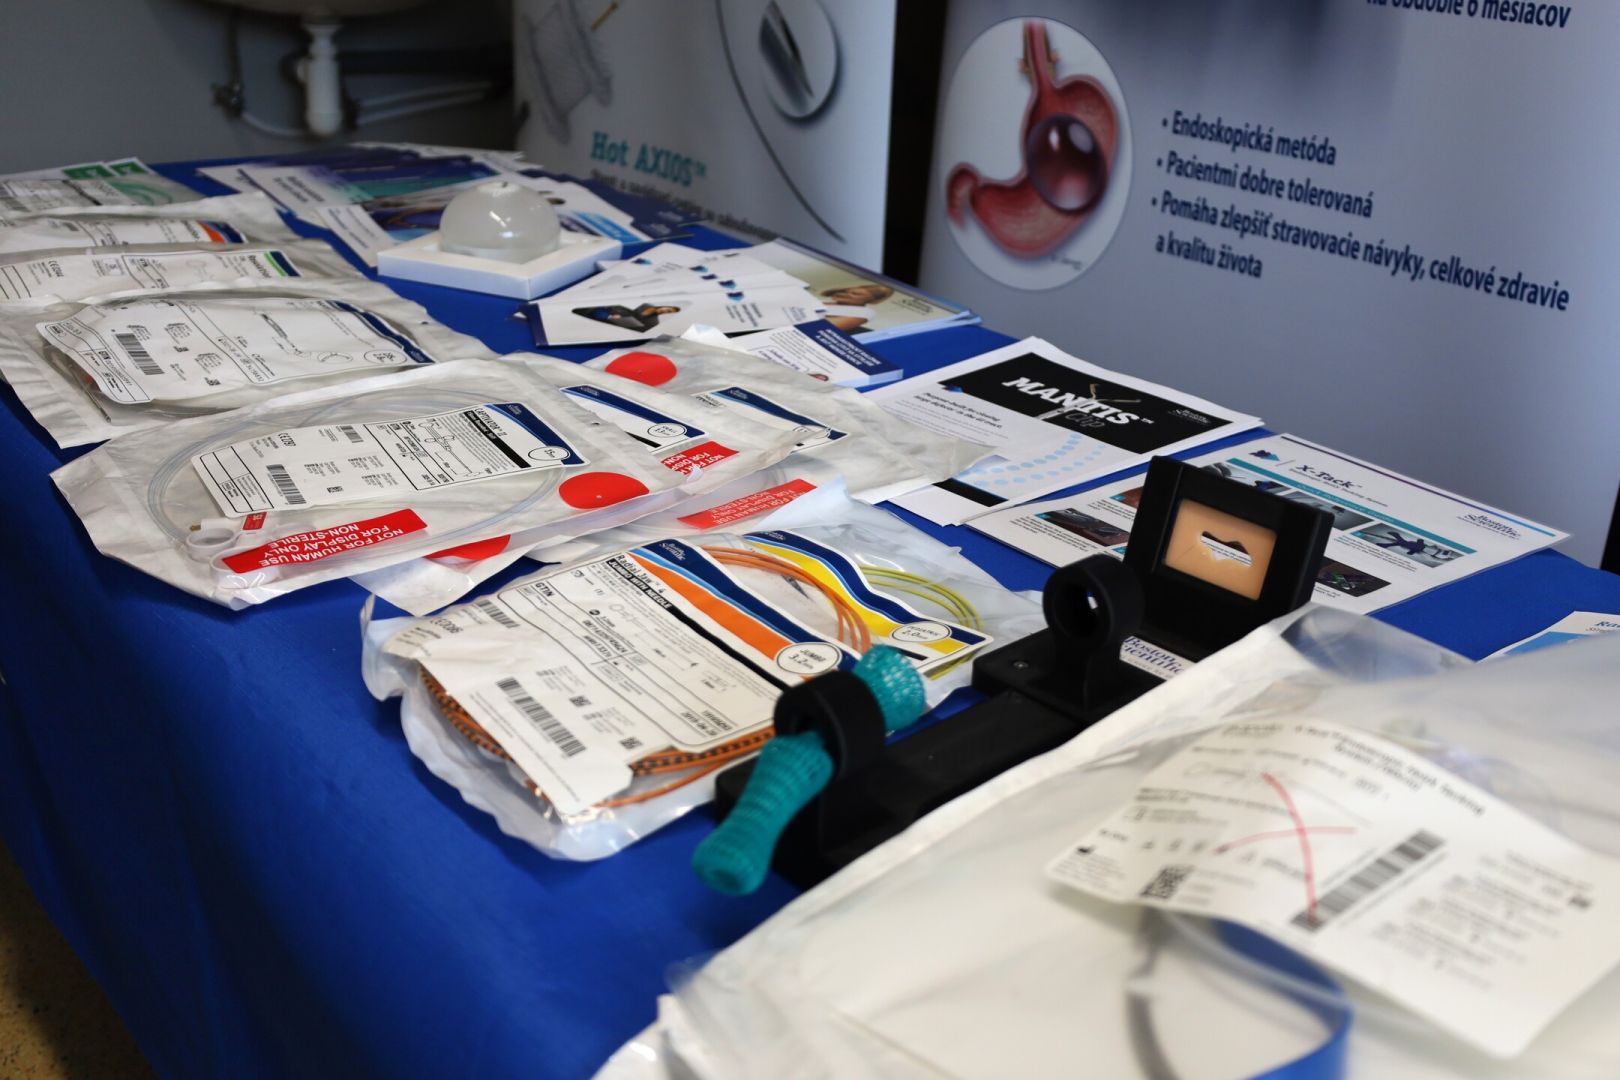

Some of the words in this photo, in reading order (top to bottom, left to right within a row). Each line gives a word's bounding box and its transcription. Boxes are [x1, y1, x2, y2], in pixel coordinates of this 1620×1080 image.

[1172, 110, 1273, 152] Endoskopická
[1275, 135, 1337, 166] metóda
[590, 130, 629, 166] Hot
[1166, 150, 1239, 188] Pacientmi
[1239, 166, 1285, 198] dobre
[1288, 178, 1374, 218] tolerovaná
[1156, 235, 1165, 254] a
[1166, 231, 1215, 265] kvalitu
[1217, 244, 1263, 279] života
[1161, 189, 1218, 225] Pomáha
[1220, 204, 1273, 238] zlepšiť
[1272, 220, 1361, 260] stravovacie
[1362, 239, 1426, 281] návyky,
[1429, 255, 1496, 294] celkové
[1497, 272, 1570, 311] zdravie
[267, 523, 359, 549] NON-STERILE
[358, 524, 389, 537] FOR
[375, 528, 403, 540] NOT
[263, 544, 299, 557] ONLY
[303, 532, 358, 551] DISPLAY
[343, 536, 374, 549] FOR
[258, 554, 289, 566] USE
[290, 545, 342, 559] HUMAN
[616, 555, 641, 574] Radial
[535, 582, 555, 597] GTIN
[646, 589, 672, 609] NEEDLE
